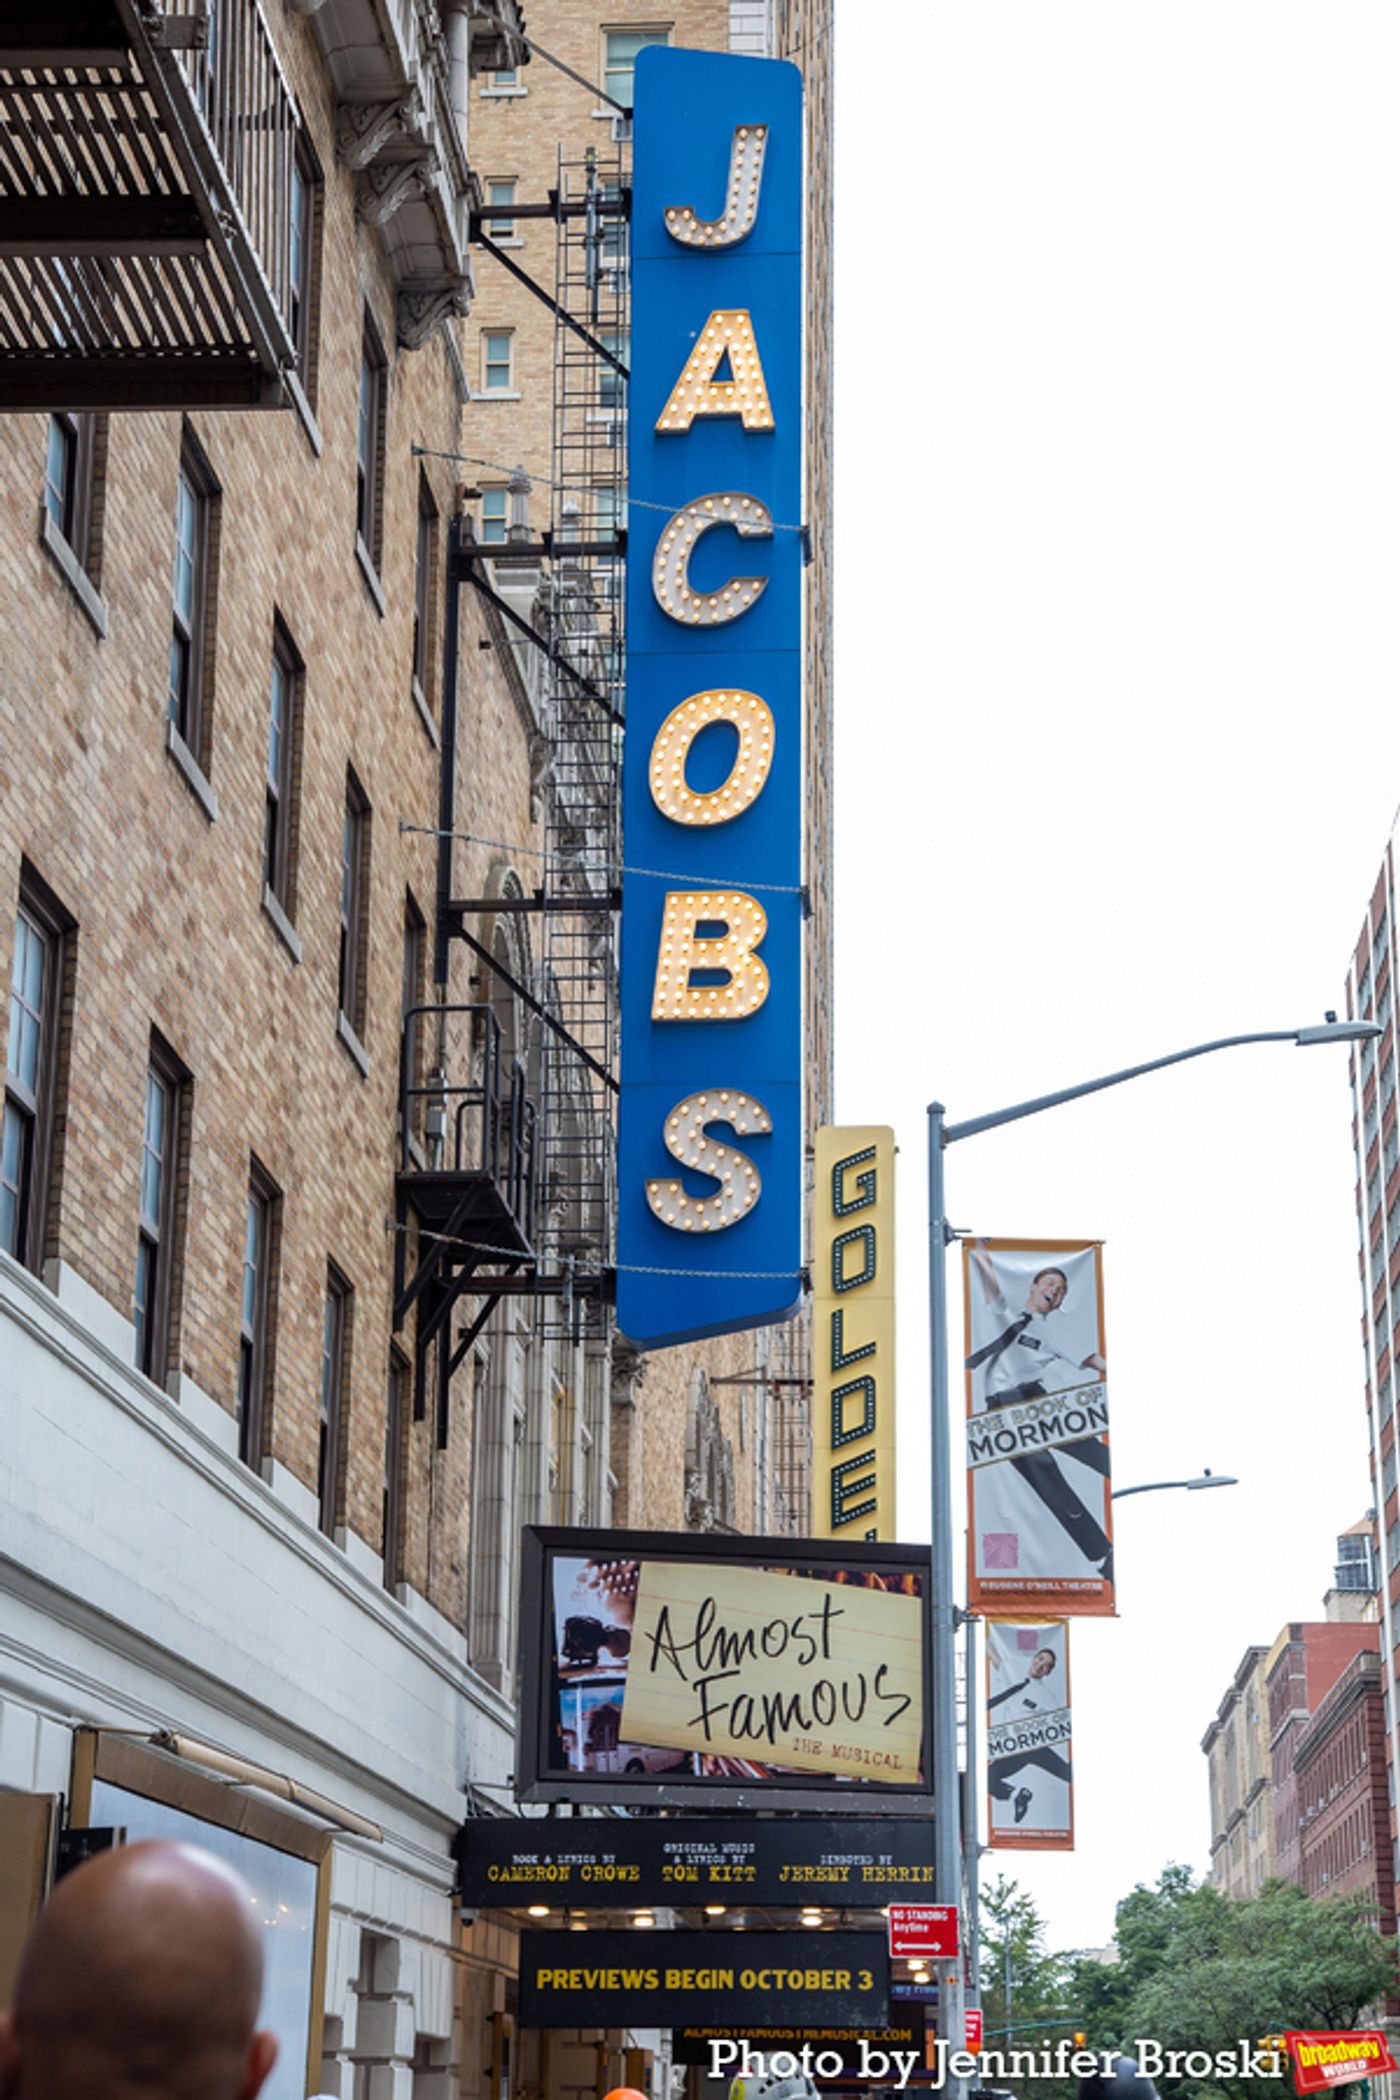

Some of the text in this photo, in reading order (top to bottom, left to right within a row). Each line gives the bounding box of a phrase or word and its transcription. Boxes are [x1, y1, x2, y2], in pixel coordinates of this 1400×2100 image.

[645, 124, 776, 1233] JACOBS
[831, 1145, 877, 1541] GOLDE
[967, 1387, 1103, 1437] THE BOOK OF
[968, 1402, 1109, 1461] MORMON
[645, 1593, 845, 1681] Almost
[793, 1737, 904, 1770] THE MUSICAL
[988, 1722, 1071, 1755] MORMON
[488, 1865, 640, 1882] CAMERON CROWE
[661, 1865, 757, 1882] TOM KITT
[778, 1866, 935, 1882] JEREMY HERRIN
[904, 1910, 949, 1921] STANDING
[536, 1968, 659, 1990] PREVIEWS
[664, 1968, 734, 1990] BEGIN
[740, 1968, 852, 1991] OCTOBER
[857, 1969, 874, 1991] 3
